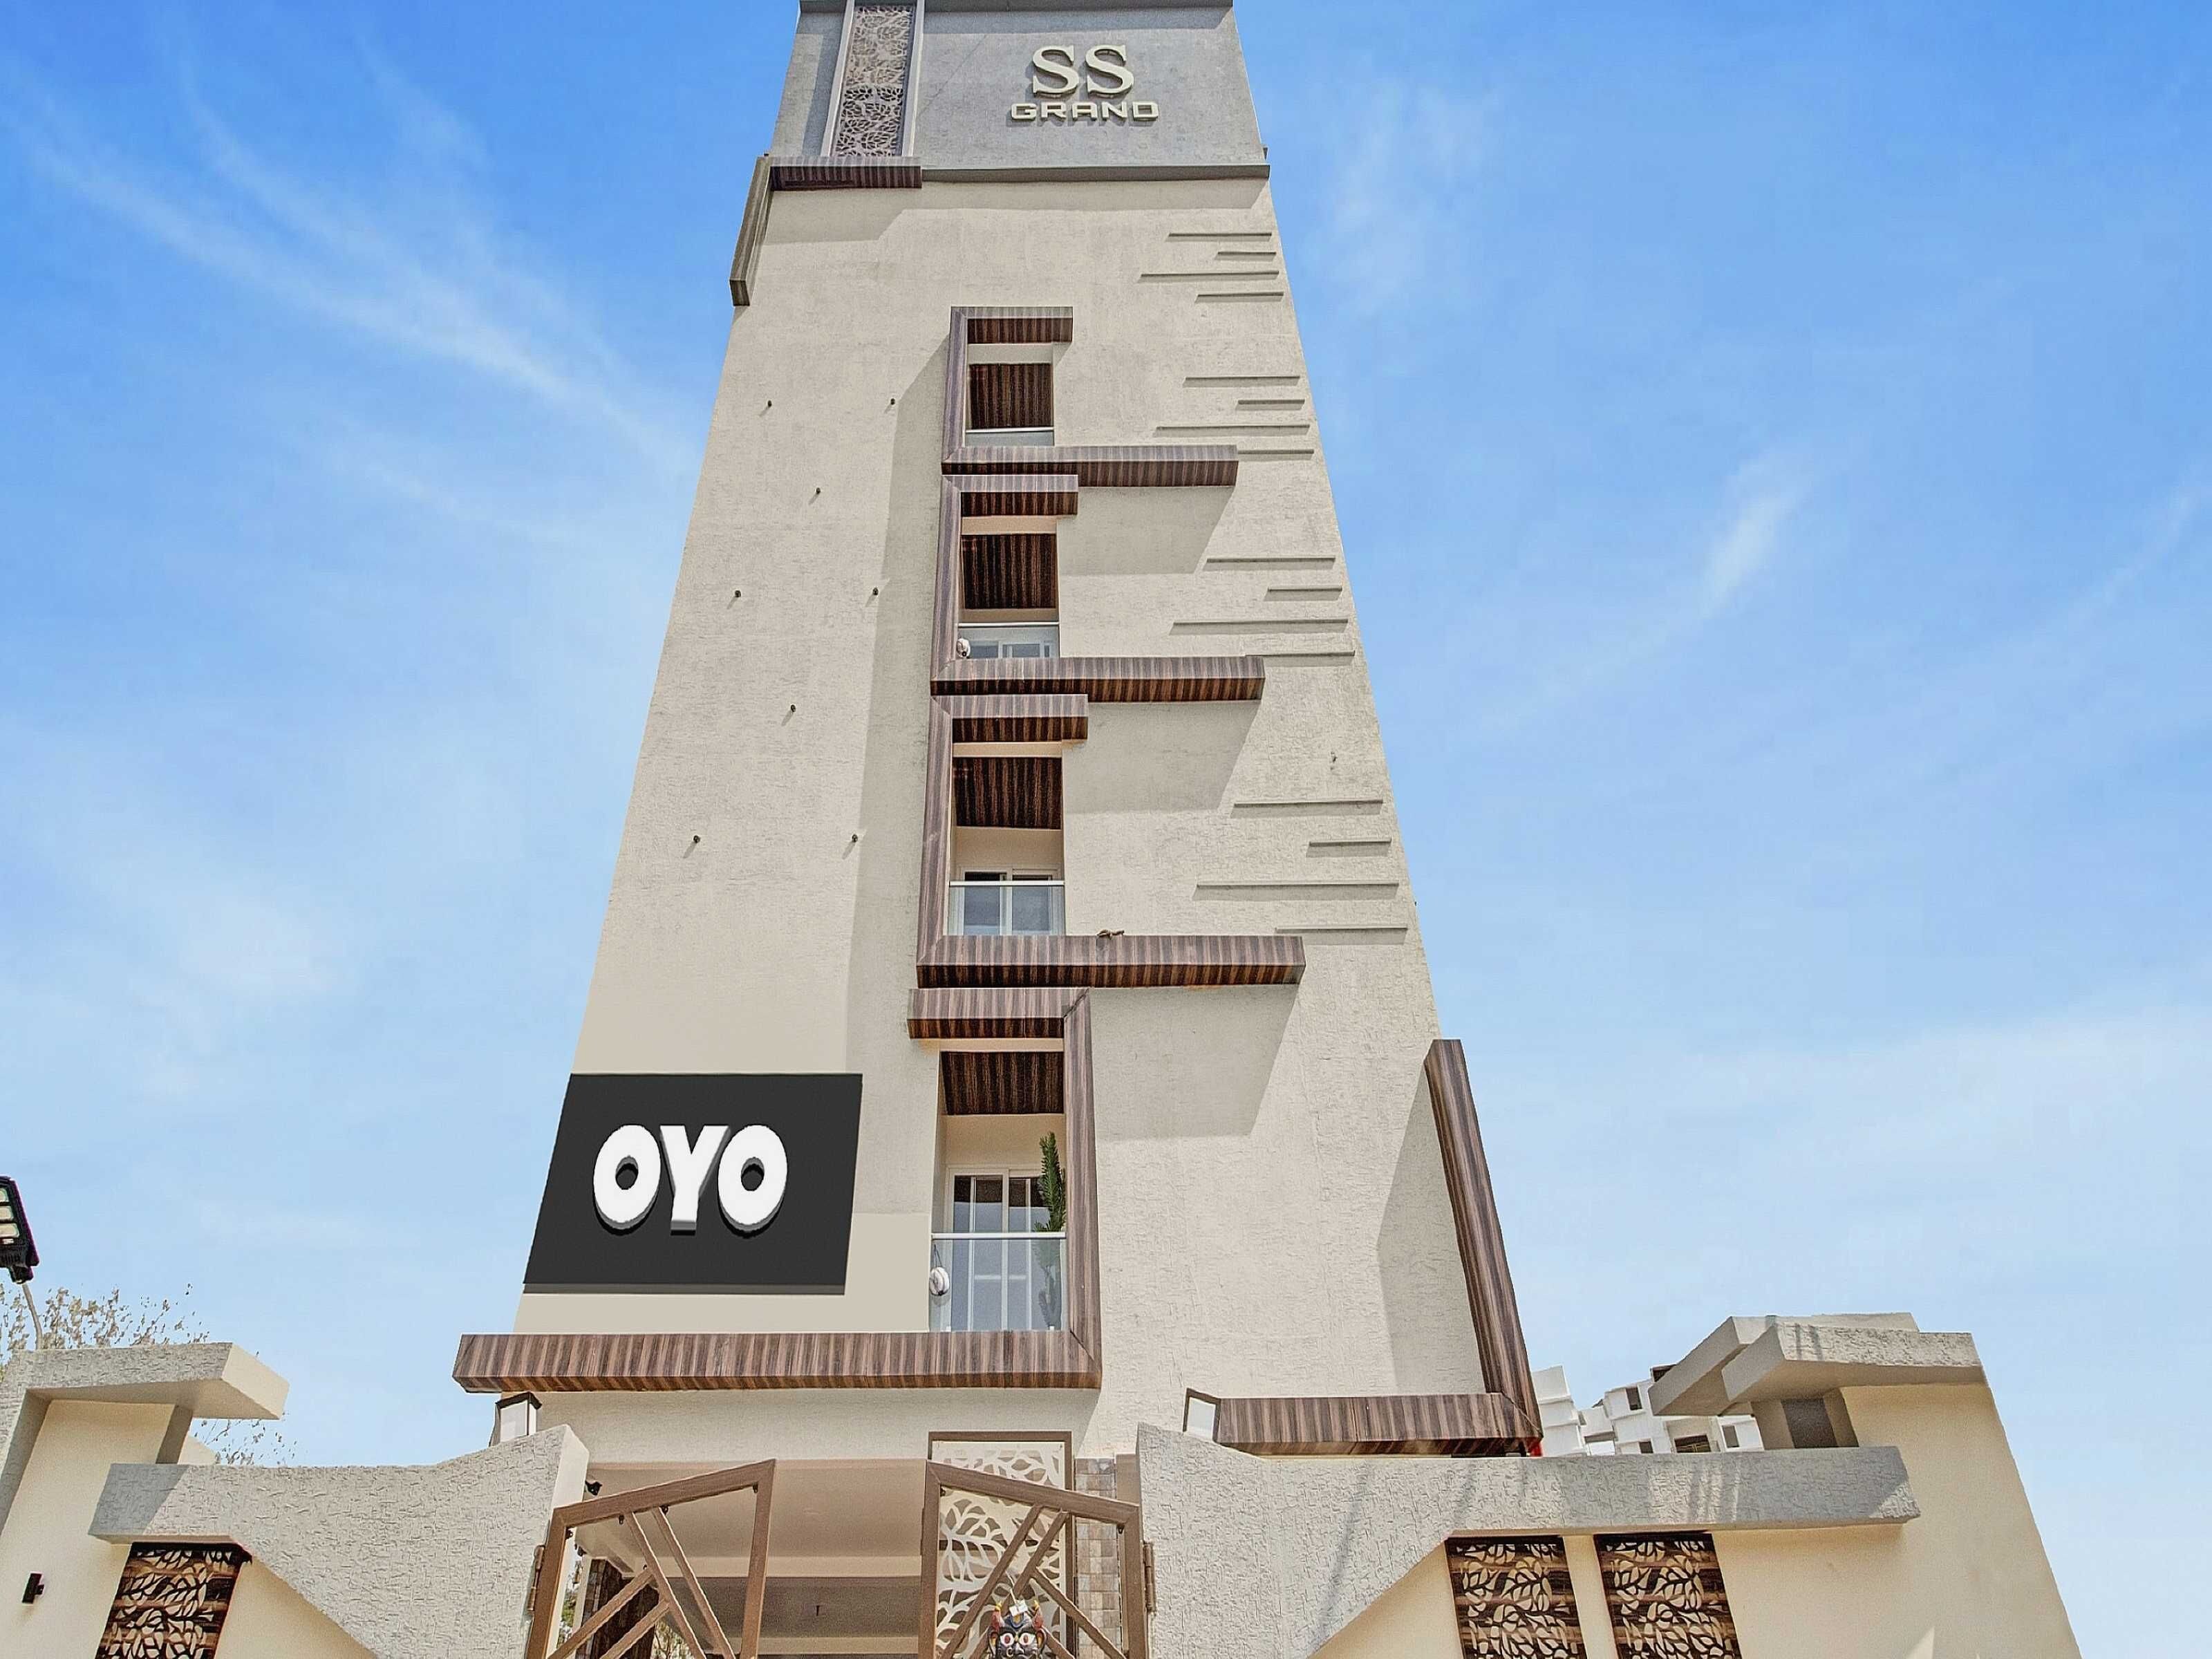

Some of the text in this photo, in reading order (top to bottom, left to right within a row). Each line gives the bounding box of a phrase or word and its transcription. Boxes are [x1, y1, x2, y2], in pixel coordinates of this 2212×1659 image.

[1032, 44, 1135, 95] SS
[1011, 100, 1160, 121] GRAND
[592, 1124, 788, 1233] OYO
